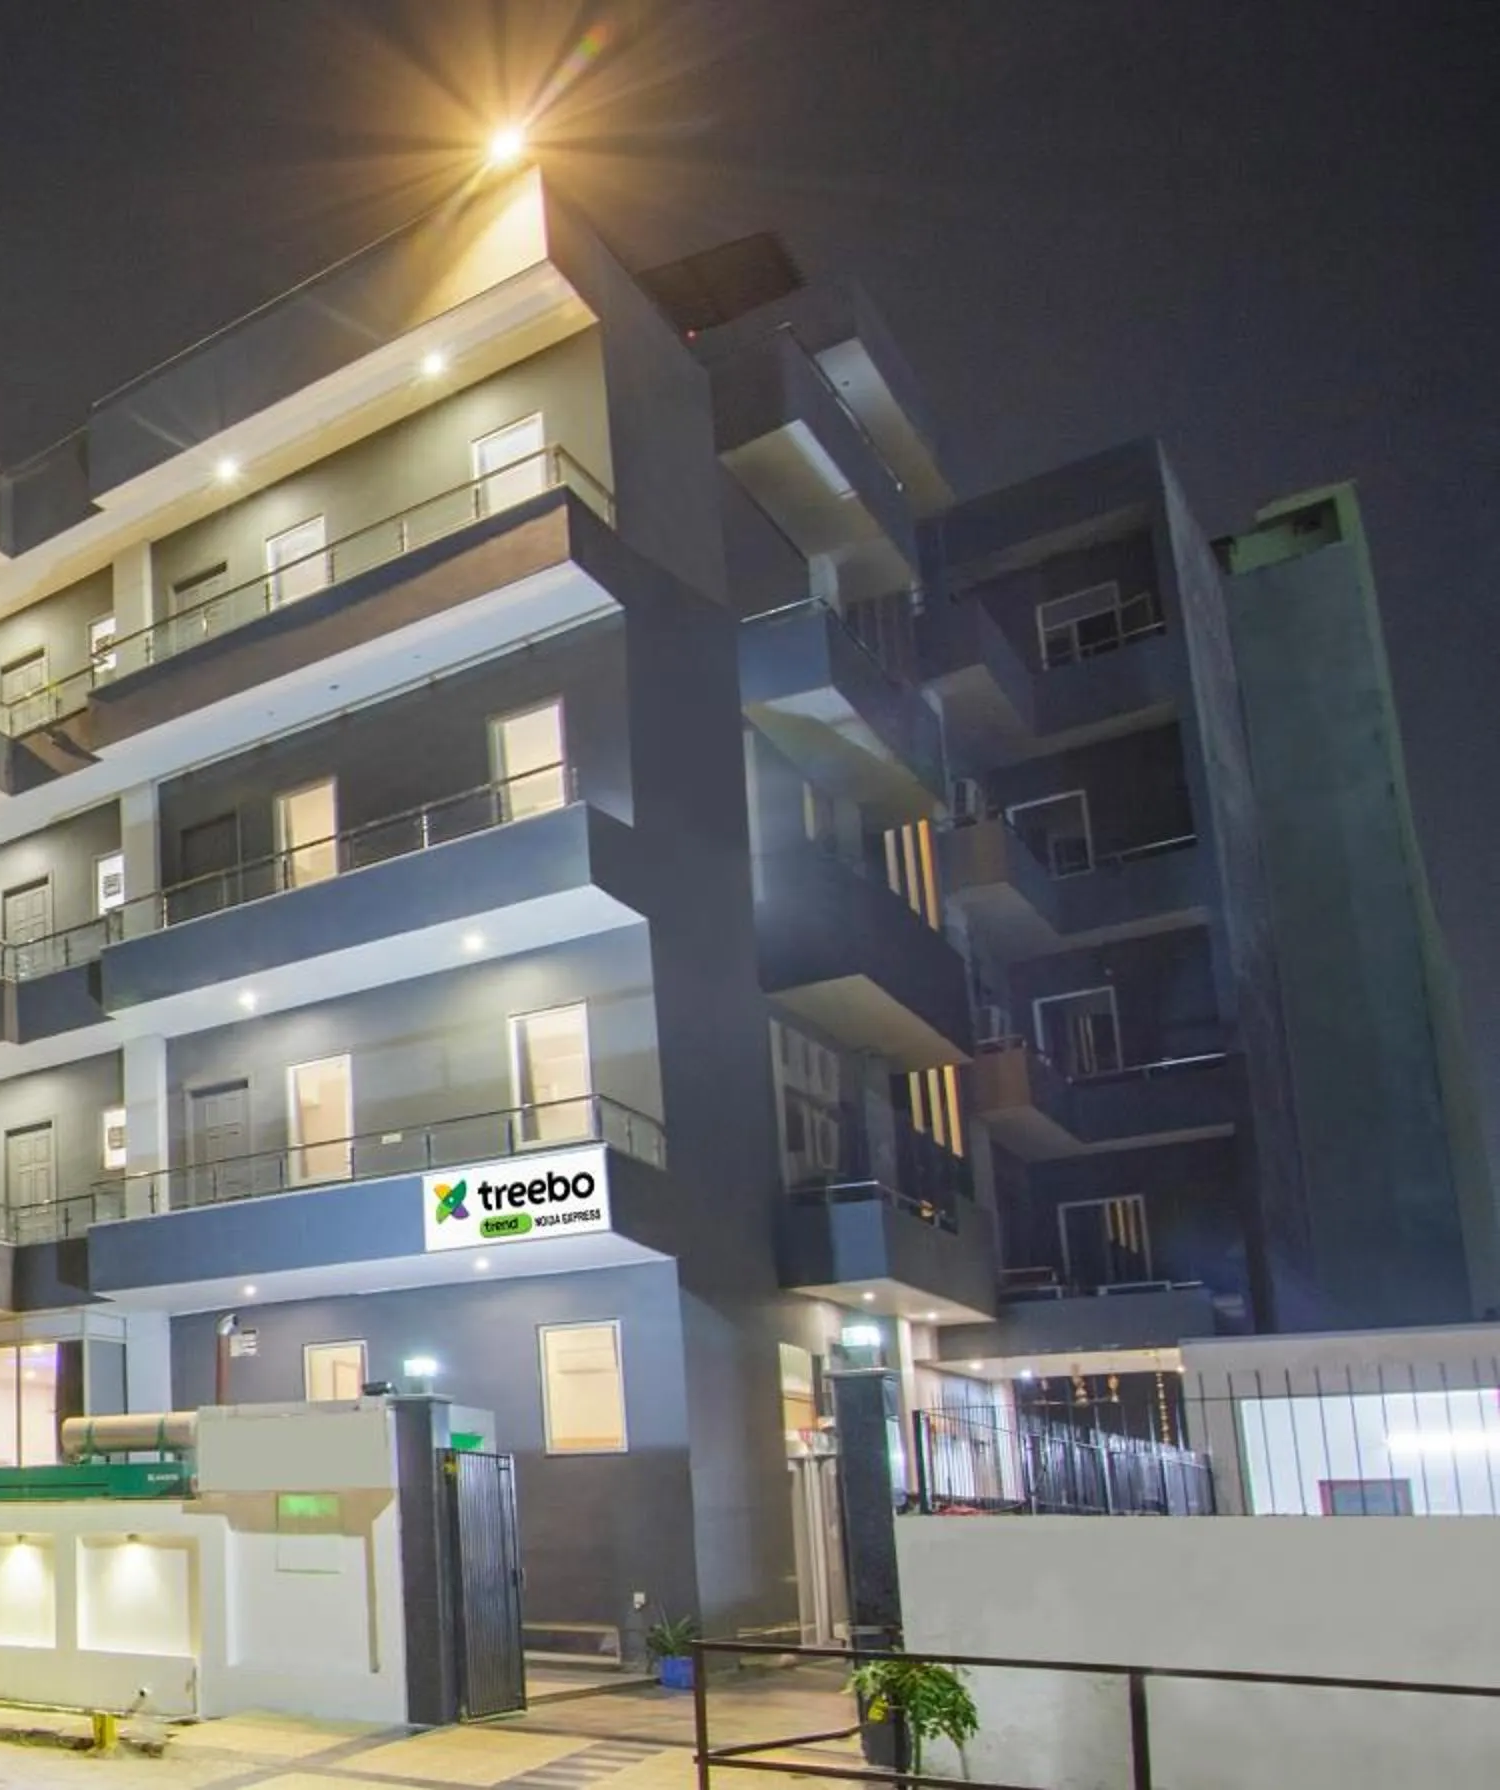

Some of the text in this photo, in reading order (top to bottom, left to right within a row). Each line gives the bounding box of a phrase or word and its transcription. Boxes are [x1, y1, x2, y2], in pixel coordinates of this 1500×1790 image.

[477, 1171, 595, 1211] treebo
[561, 1208, 601, 1224] EXPRESS
[484, 1218, 519, 1232] trend
